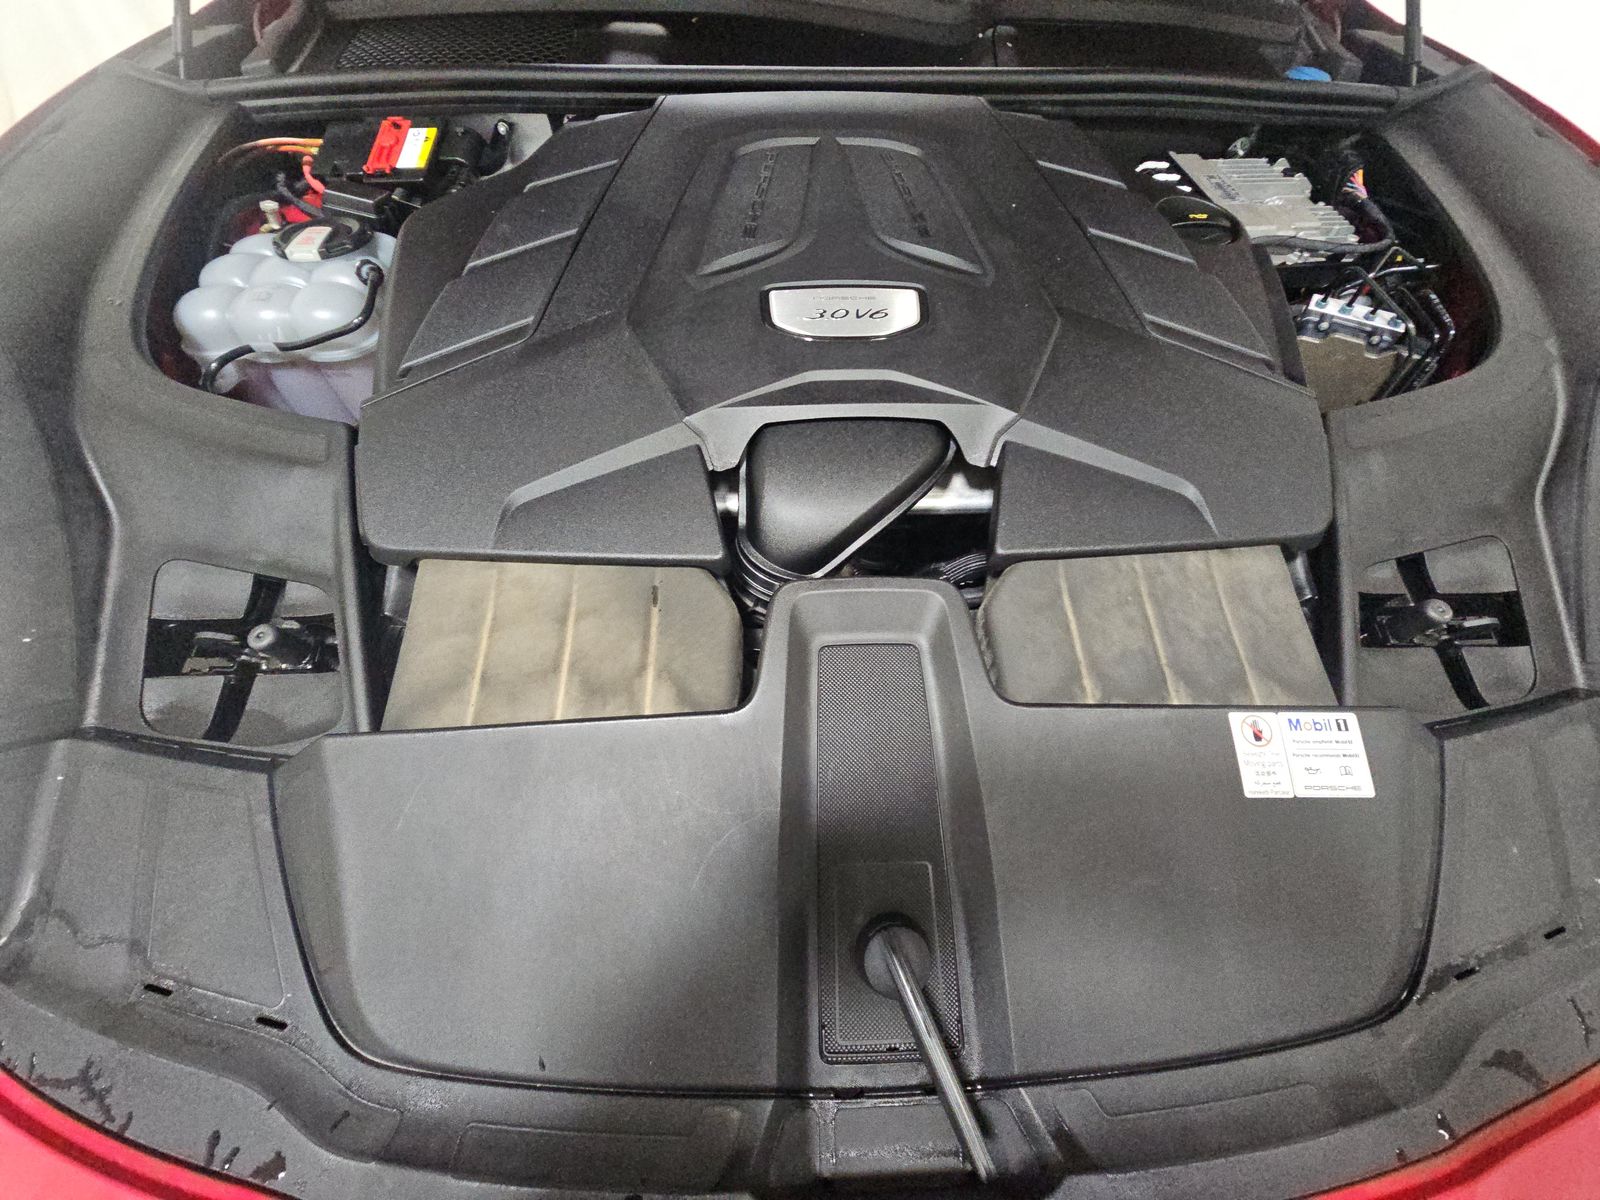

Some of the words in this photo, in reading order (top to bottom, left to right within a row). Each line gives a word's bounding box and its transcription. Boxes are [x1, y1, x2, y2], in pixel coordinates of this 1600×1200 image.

[855, 308, 889, 320] V6
[1288, 718, 1332, 732] Mobil
[1335, 718, 1349, 732] 1
